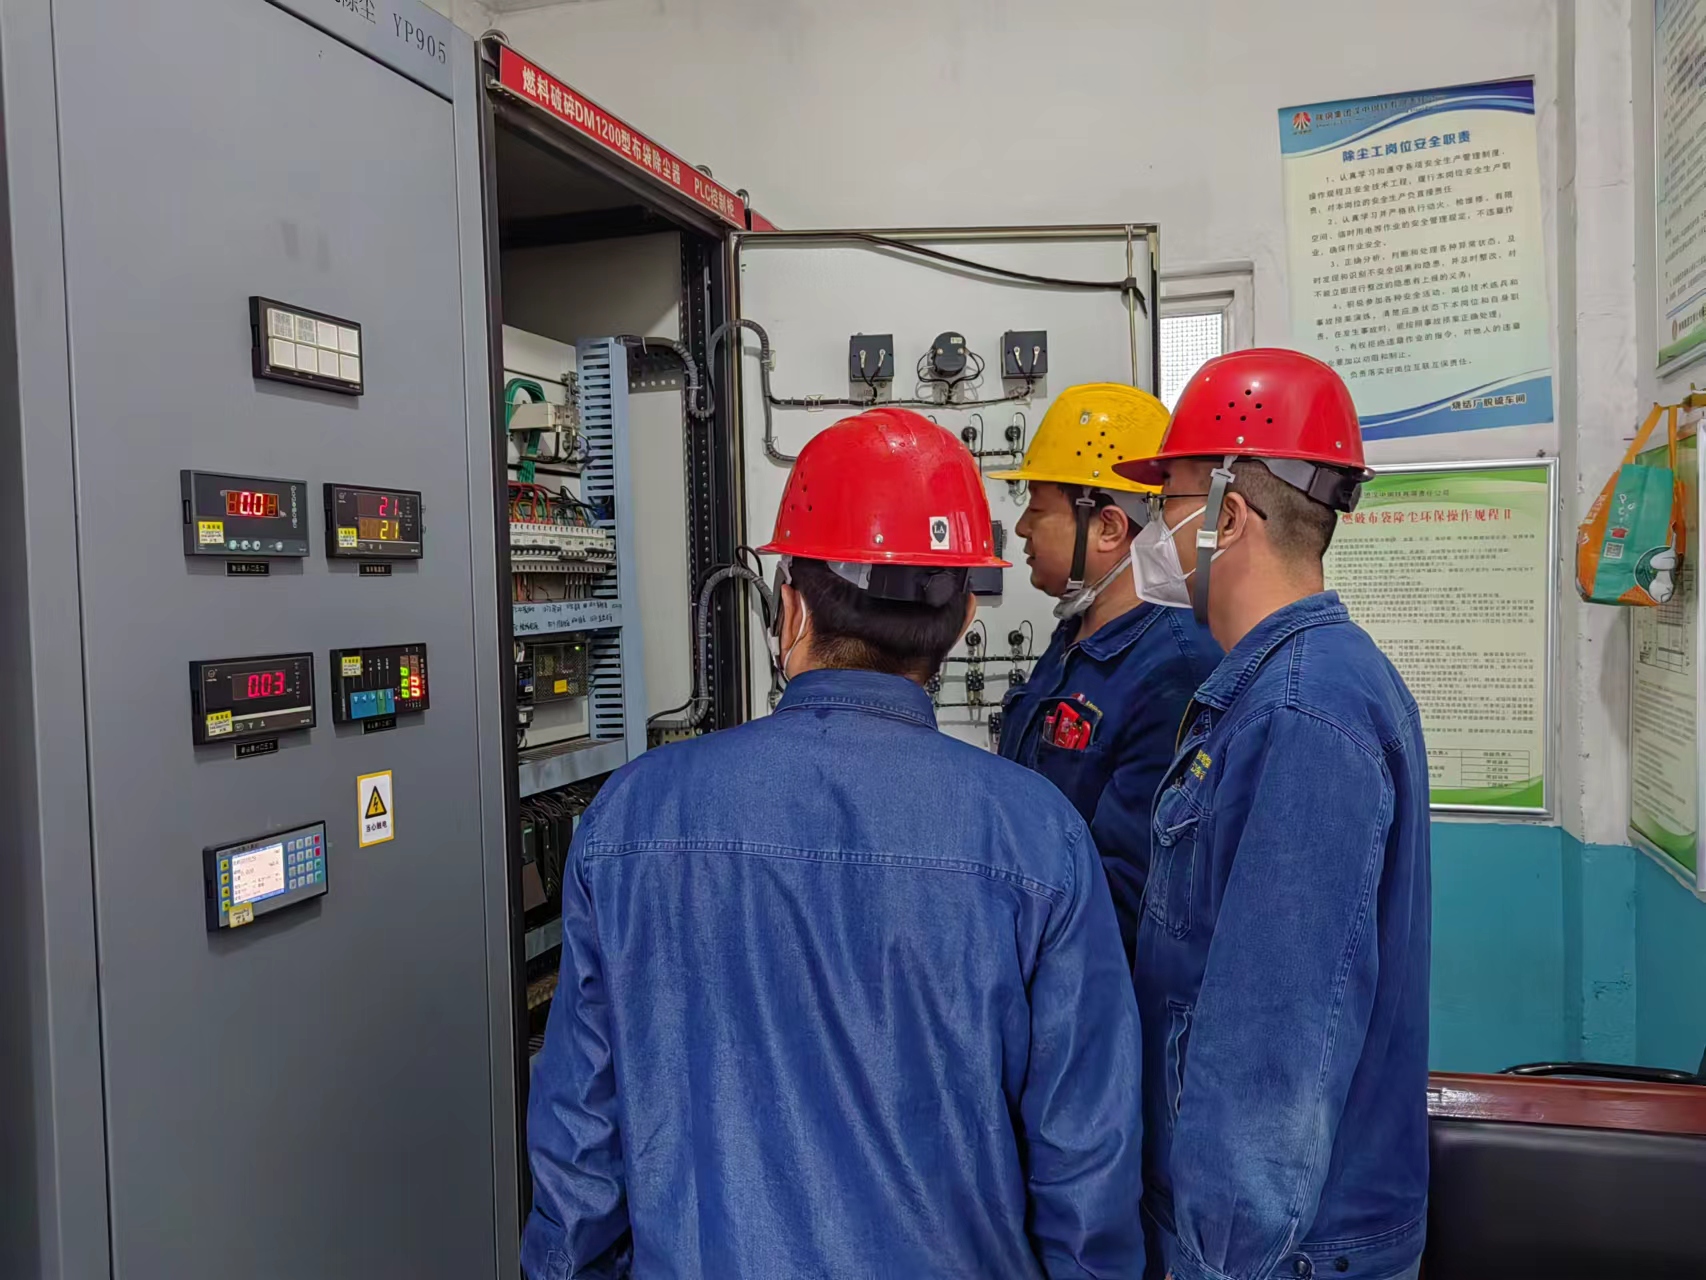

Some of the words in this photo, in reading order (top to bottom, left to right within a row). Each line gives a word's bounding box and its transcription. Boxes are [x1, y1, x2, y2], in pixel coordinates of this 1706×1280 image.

[393, 12, 446, 64] YP905
[521, 65, 682, 186] 燃料破碎DM1200型布袋除尘器
[1342, 130, 1471, 163] 除尘工岗位安全职责
[1450, 393, 1526, 411] 烧结厂脱硫车间
[380, 496, 399, 516] 21
[380, 520, 399, 539] 21
[248, 672, 285, 698] 0.03
